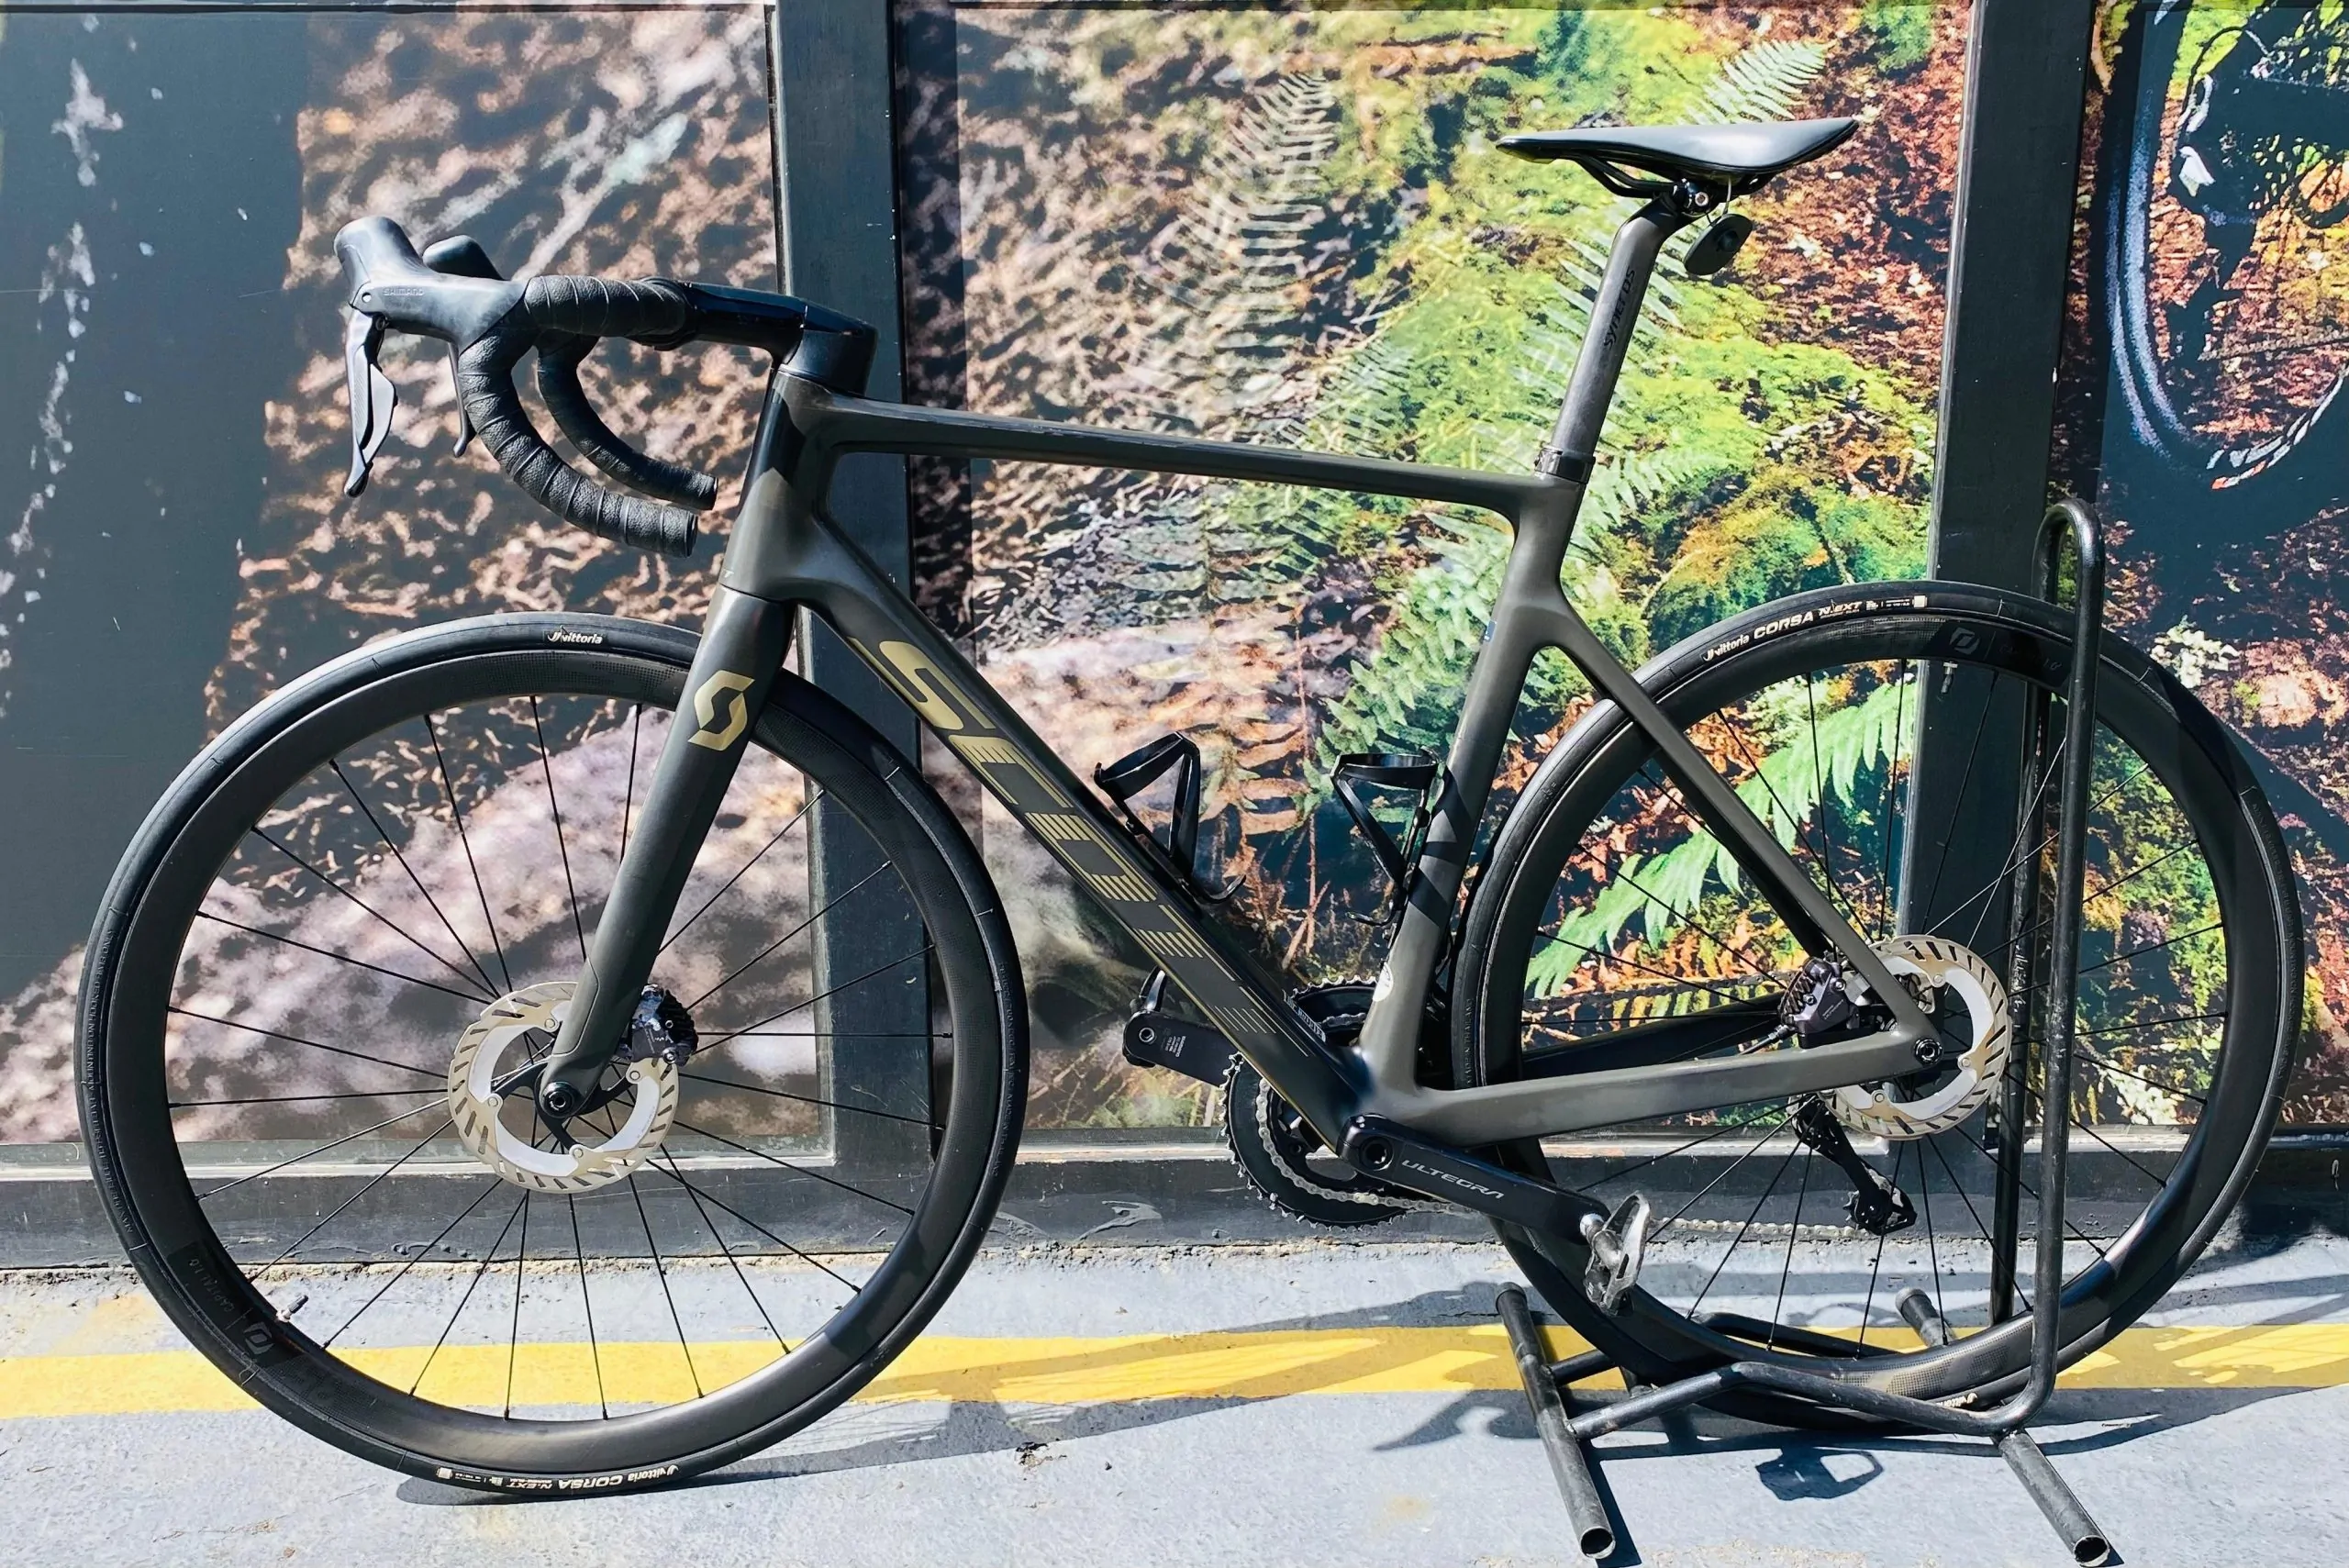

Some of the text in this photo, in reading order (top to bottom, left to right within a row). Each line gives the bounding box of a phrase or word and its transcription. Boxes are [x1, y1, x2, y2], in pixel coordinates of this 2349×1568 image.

[562, 631, 603, 644] vittoria
[1714, 633, 1750, 658] vittoria
[1753, 611, 1814, 639] CORSA
[1402, 1160, 1505, 1199] ULTEGRA
[628, 1467, 668, 1482] vittoria
[558, 1476, 622, 1489] CORSA
